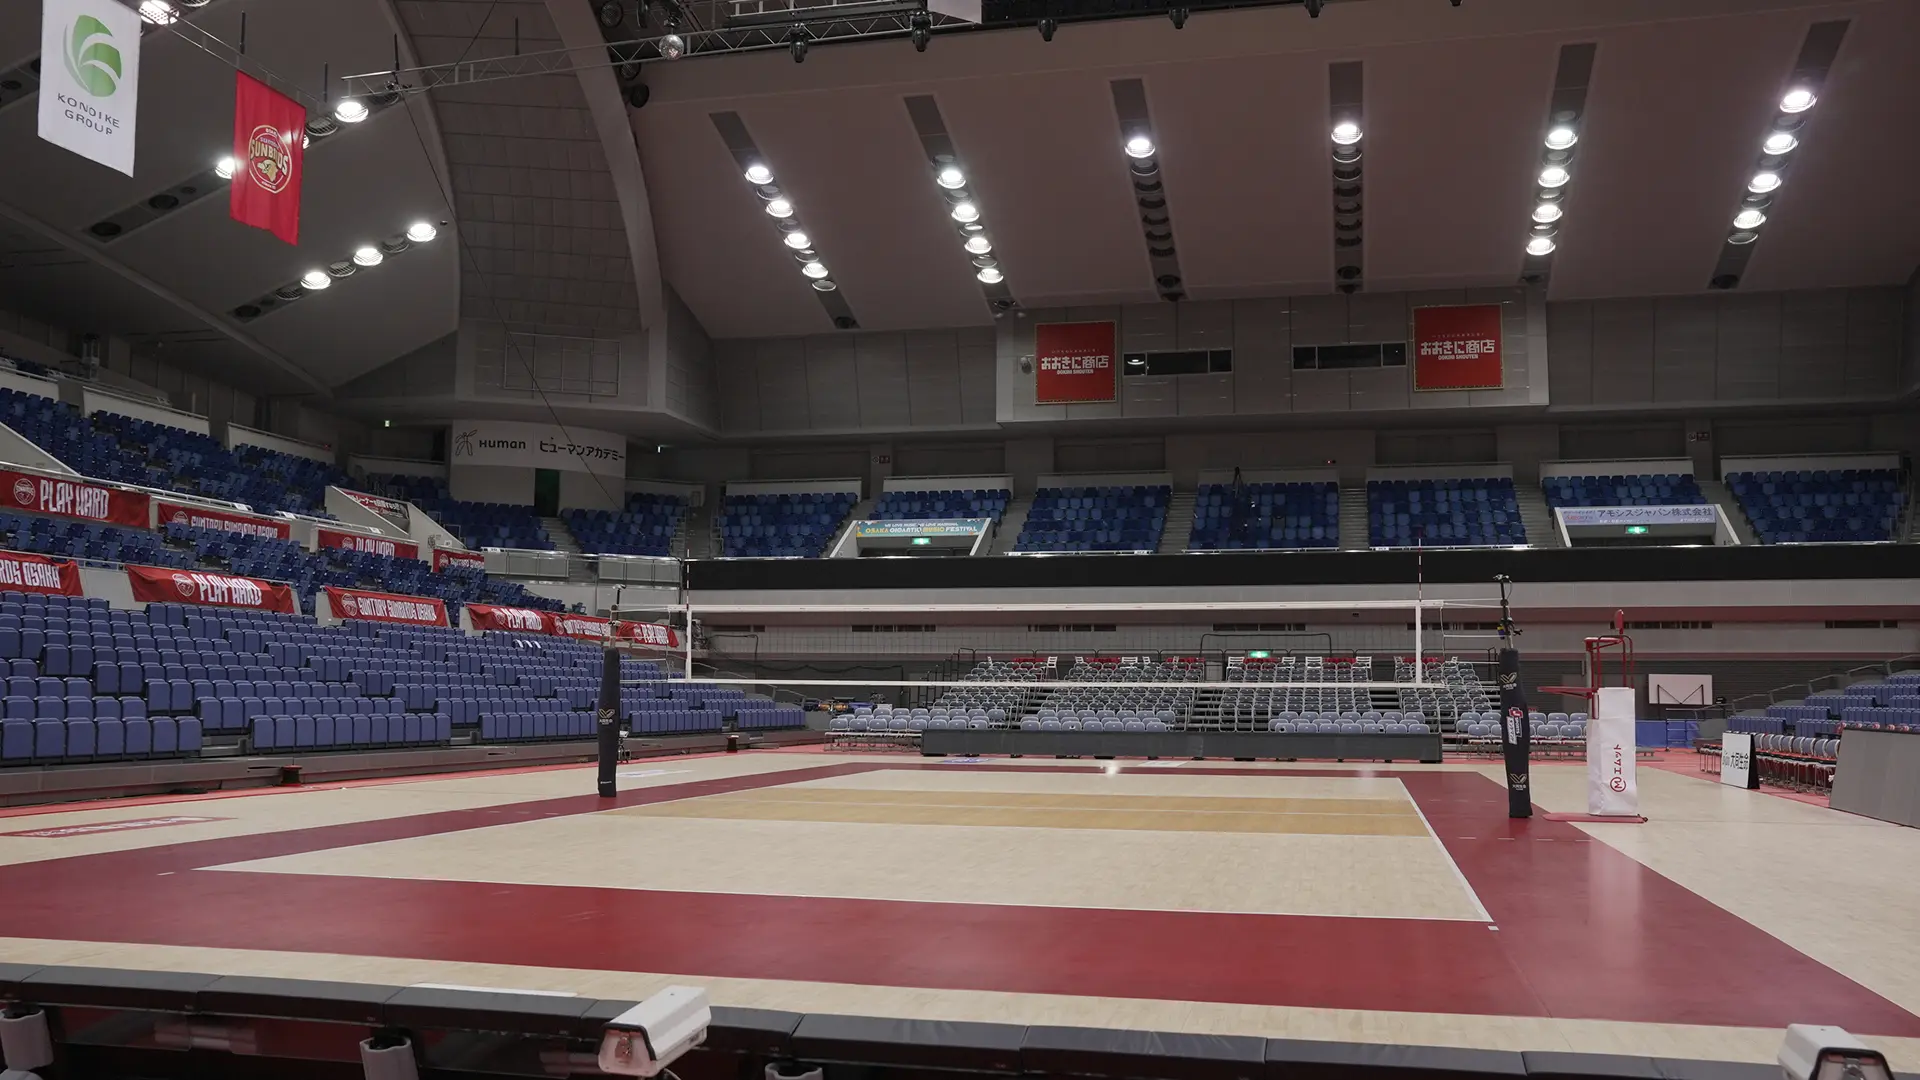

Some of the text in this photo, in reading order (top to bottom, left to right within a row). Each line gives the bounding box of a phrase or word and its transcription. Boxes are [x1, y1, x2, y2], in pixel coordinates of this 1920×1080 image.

[57, 92, 120, 128] KONOIKE
[64, 109, 113, 135] GROUP
[1421, 339, 1496, 355] おおきに商店
[1041, 354, 1110, 370] おおきに商店
[539, 440, 626, 461] ヒューマンアカデミー
[40, 479, 110, 519] PLAY HARD
[1596, 507, 1713, 518] アモシスジャパン株式会社
[22, 561, 61, 589] OSAKA
[191, 573, 229, 603] PLAY
